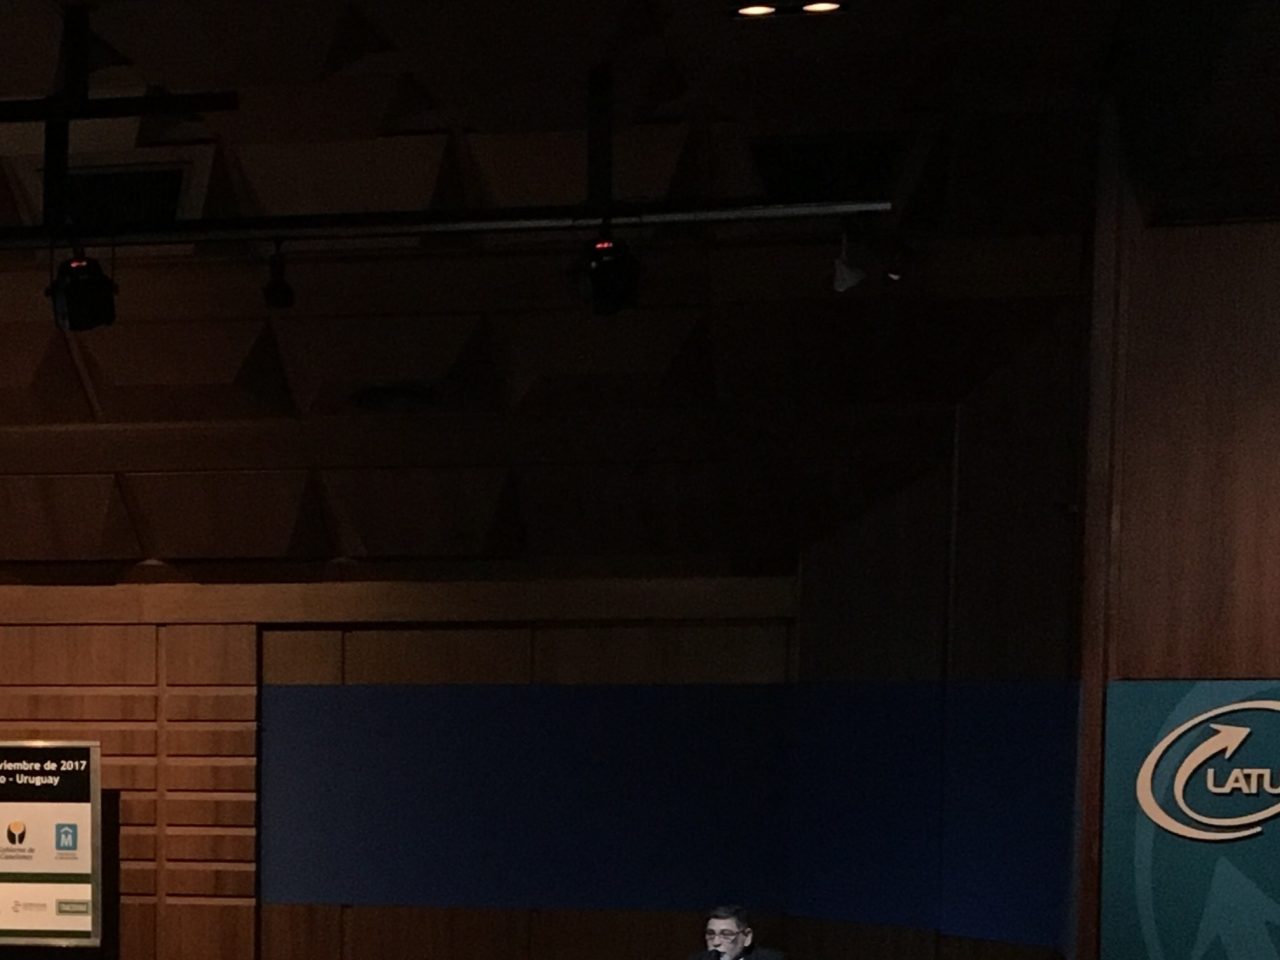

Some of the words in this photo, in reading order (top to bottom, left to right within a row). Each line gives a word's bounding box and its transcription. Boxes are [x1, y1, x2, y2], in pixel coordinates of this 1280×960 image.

[43, 760, 57, 771] de
[60, 760, 87, 771] 2017
[16, 774, 60, 786] Uruguay
